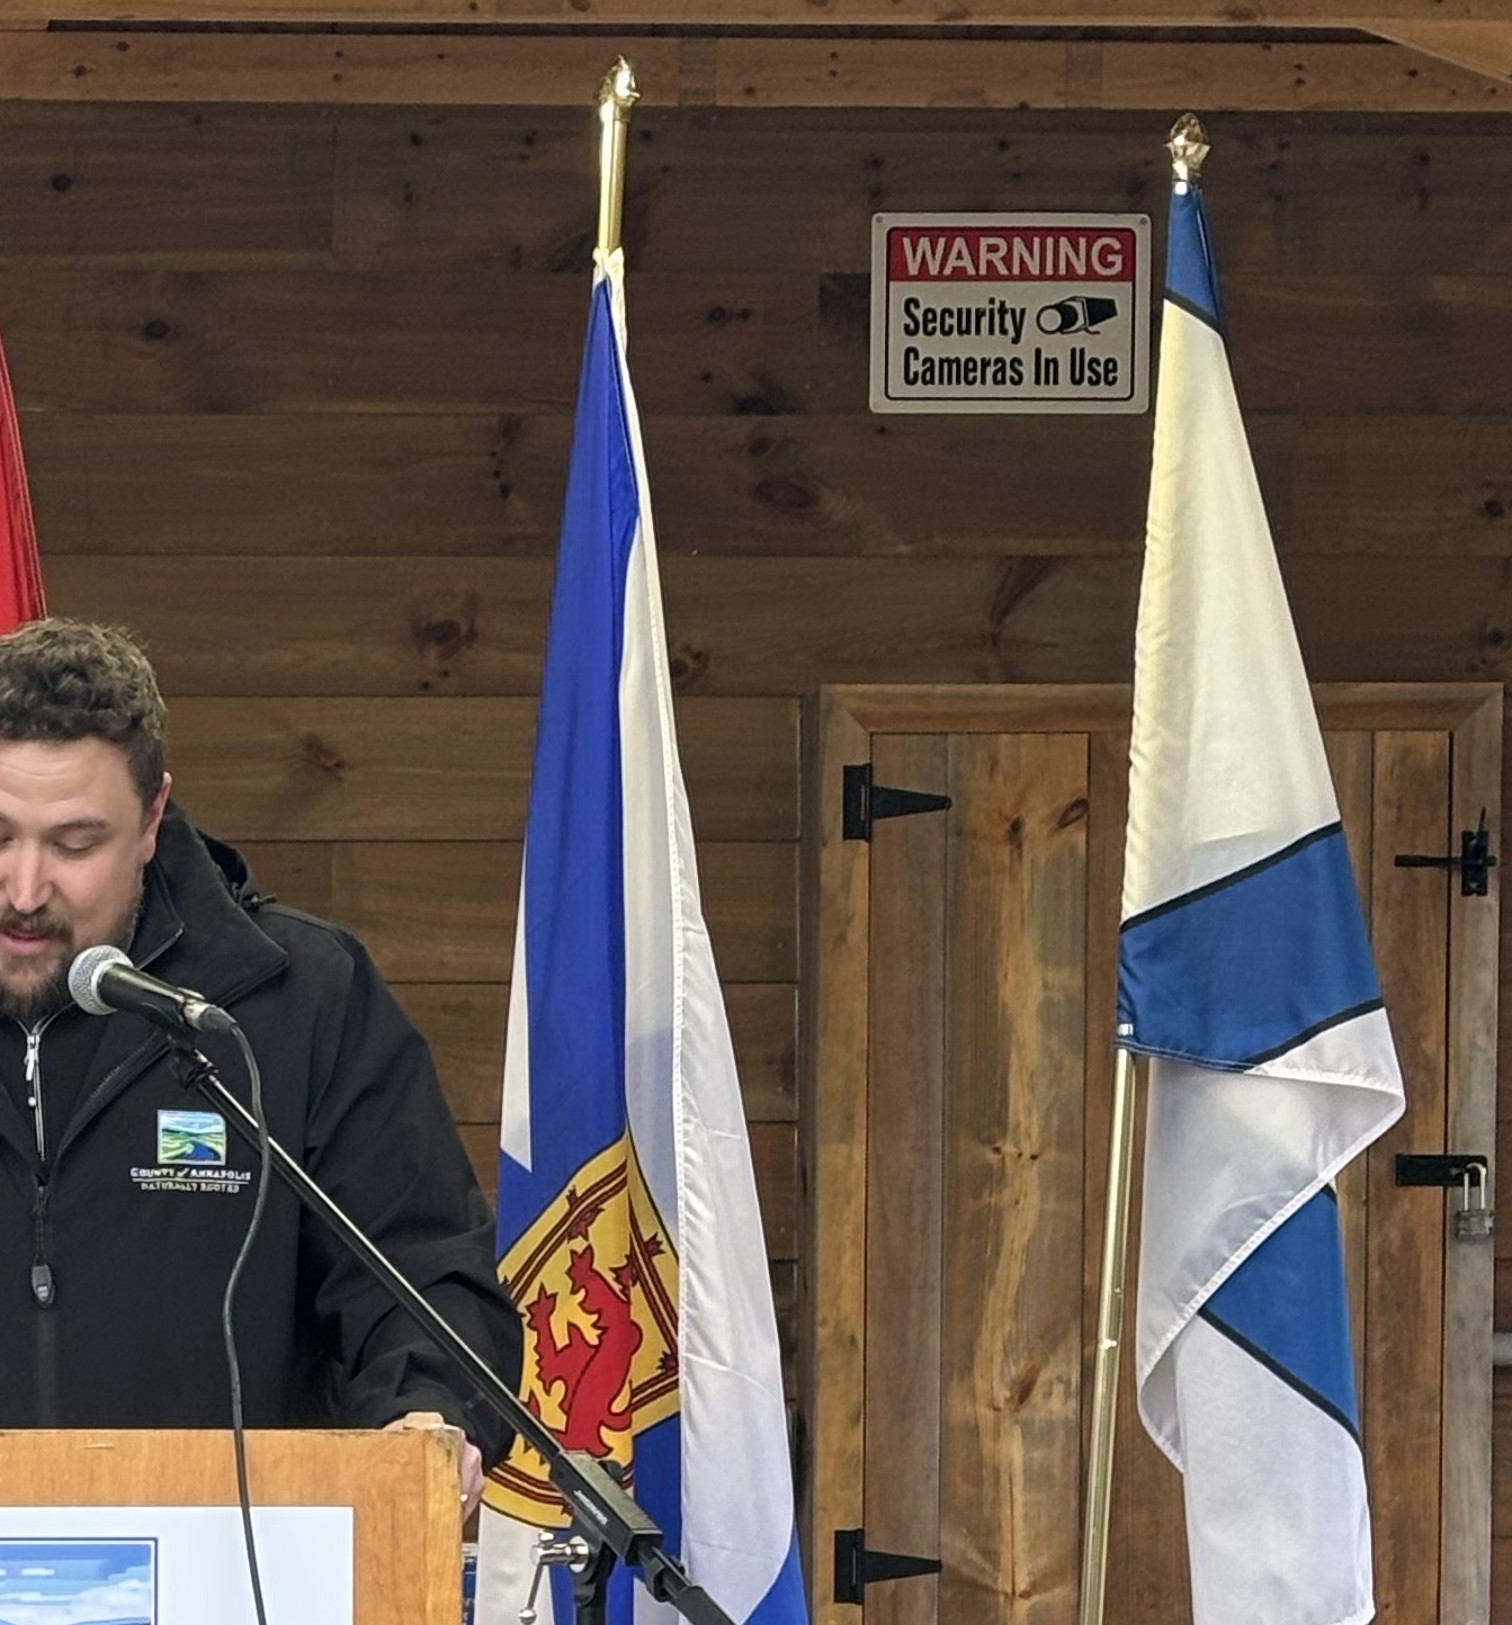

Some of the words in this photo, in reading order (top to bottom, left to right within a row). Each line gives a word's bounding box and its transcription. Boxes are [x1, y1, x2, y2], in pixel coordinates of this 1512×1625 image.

[902, 236, 1123, 276] WARNING
[903, 297, 1026, 345] Security
[903, 346, 1024, 387] Cameras
[1034, 347, 1059, 386] In
[1070, 347, 1119, 387] Use
